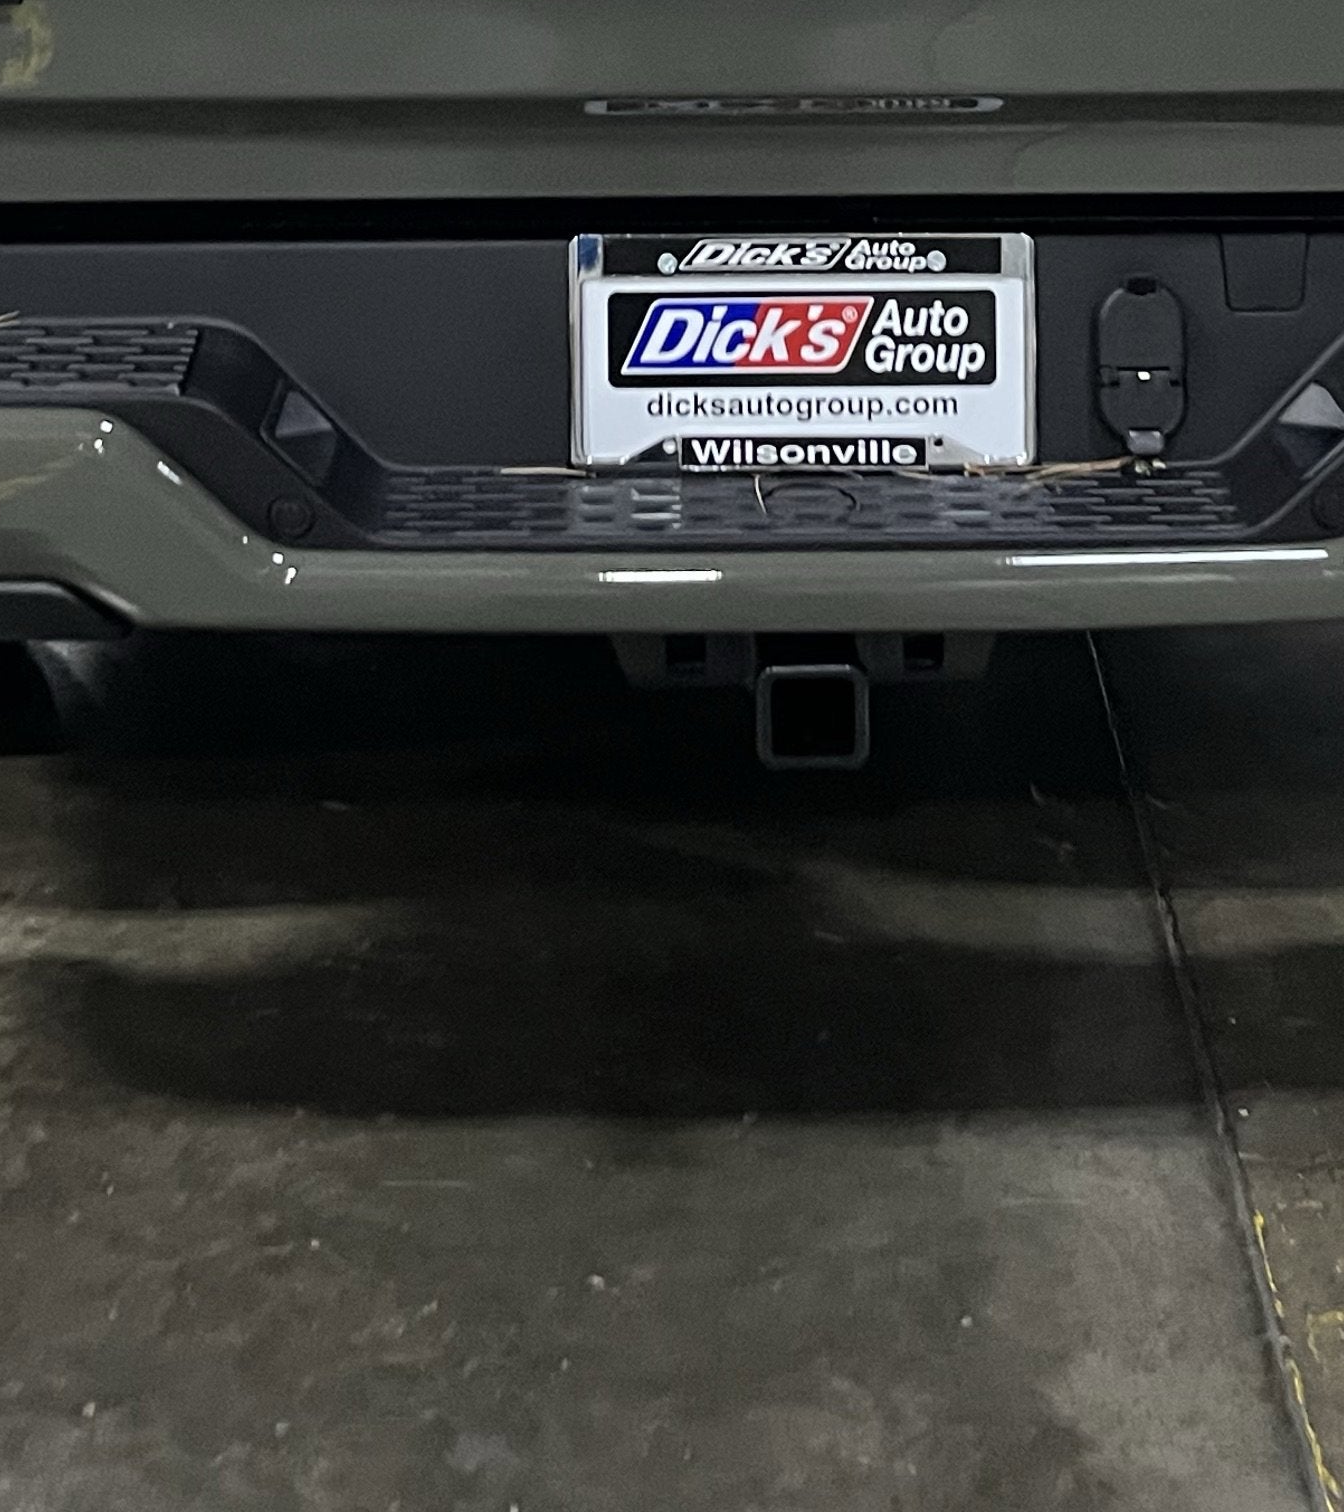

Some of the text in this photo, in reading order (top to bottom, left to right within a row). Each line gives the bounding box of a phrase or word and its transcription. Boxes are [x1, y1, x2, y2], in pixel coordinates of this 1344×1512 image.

[690, 239, 916, 267] Dick's Auto
[845, 253, 927, 273] Group
[639, 299, 969, 365] Dick's Auto
[864, 335, 986, 380] Group
[646, 392, 958, 421] dicksautogroup.com
[690, 438, 918, 465] Wilsonville
